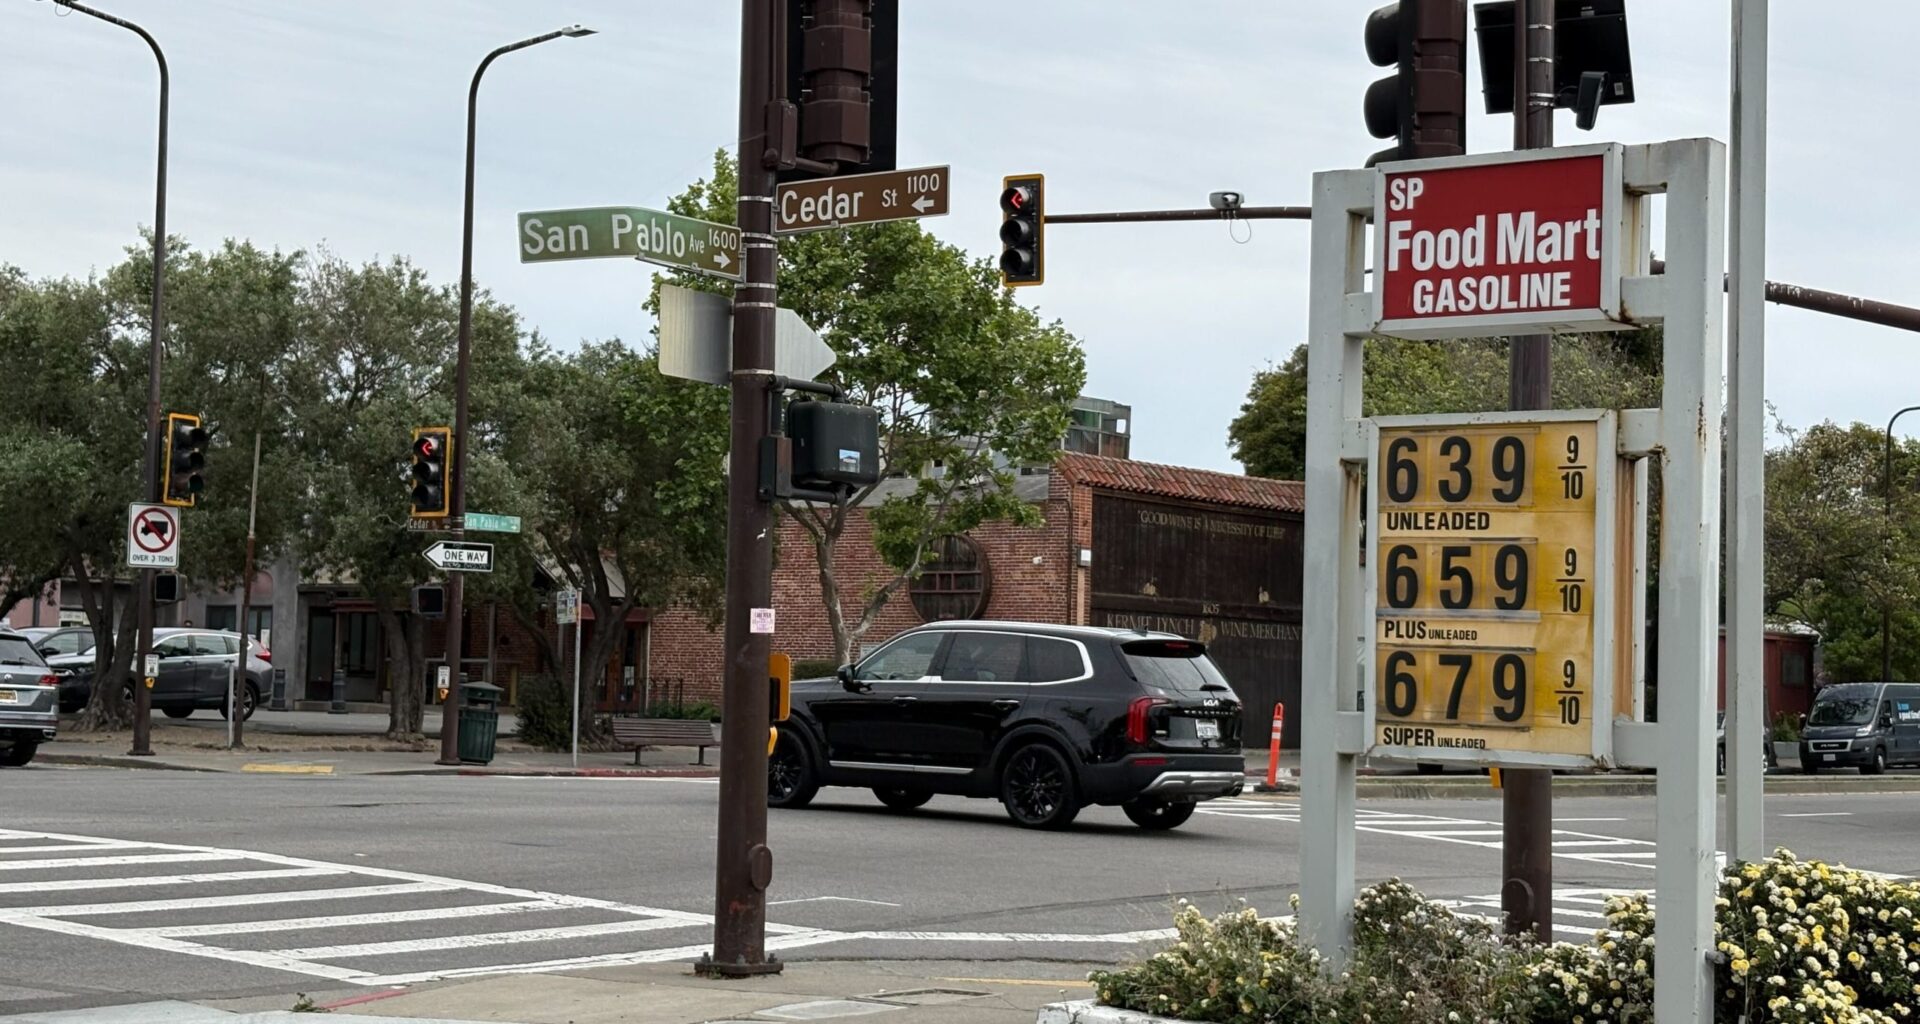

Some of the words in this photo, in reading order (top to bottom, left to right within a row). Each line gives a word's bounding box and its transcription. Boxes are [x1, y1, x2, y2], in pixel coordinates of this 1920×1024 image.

[781, 189, 864, 225] Cedar
[881, 189, 898, 208] St
[906, 173, 940, 196] 1100
[1390, 177, 1424, 211] SP
[523, 218, 589, 255] San
[611, 213, 686, 259] Pablo
[689, 233, 705, 255] Ave
[708, 227, 737, 251] 1600
[1387, 214, 1486, 272] Food
[1496, 208, 1601, 265] Mart
[1413, 271, 1571, 314] GASOLINE
[1386, 436, 1526, 503] 639
[409, 518, 429, 529] Cedar
[464, 514, 477, 527] San
[480, 515, 498, 529] Pablo
[1168, 513, 1193, 529] WINE
[1386, 511, 1490, 531] UNLEADED
[132, 554, 149, 562] OVER
[157, 555, 174, 563] TONS
[444, 550, 464, 561] ONE
[466, 551, 485, 562] WAY
[1385, 544, 1528, 611] 659
[1220, 621, 1248, 638] WINE
[1384, 620, 1427, 640] PLUS
[1428, 628, 1478, 641] UNLEADED
[1383, 650, 1527, 723] 679
[1383, 727, 1435, 747] SUPER
[1437, 737, 1486, 750] UNLEADED
